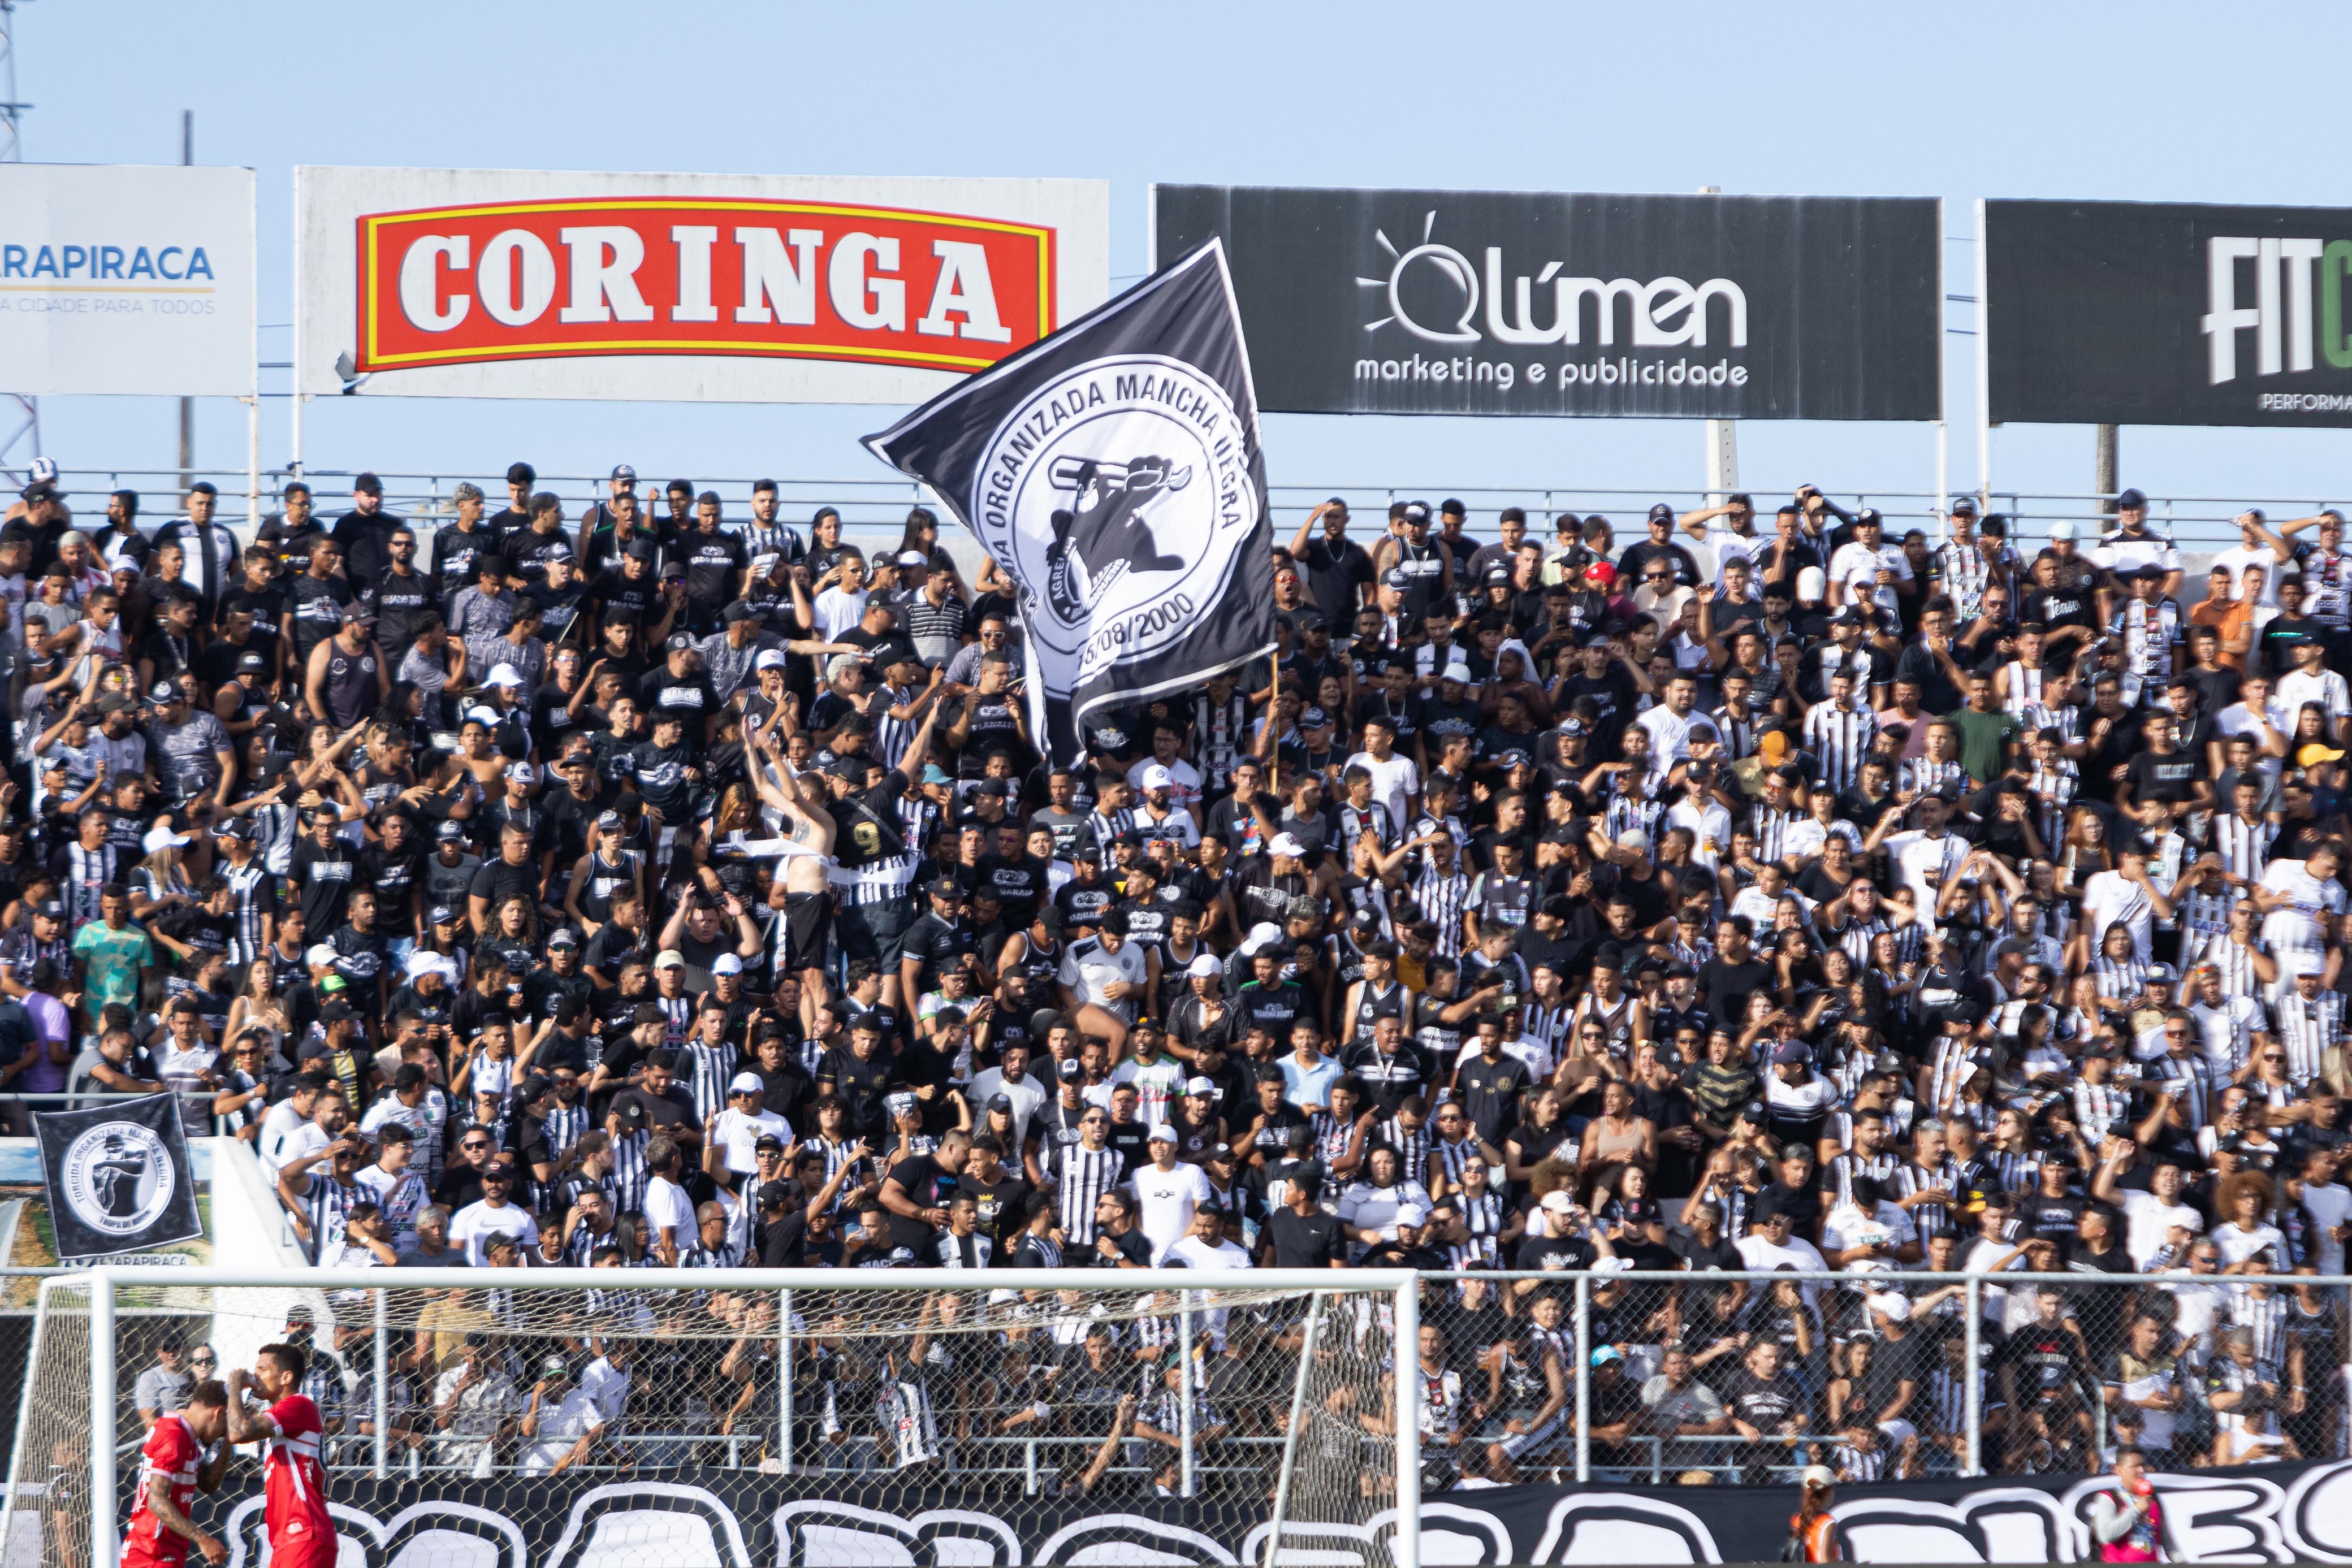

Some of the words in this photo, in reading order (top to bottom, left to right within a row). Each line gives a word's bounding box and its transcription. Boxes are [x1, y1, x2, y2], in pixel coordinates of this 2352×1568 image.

[0, 244, 215, 279] RAPIRACA
[399, 225, 1011, 343] CORINGA
[19, 297, 88, 313] CIDADE
[94, 298, 145, 313] PARA
[150, 299, 215, 314] TODOS
[1356, 354, 1514, 391] marketing
[1527, 362, 1546, 383] e
[1559, 357, 1749, 389] publicidade
[987, 381, 1105, 529] ORGANIZADA
[1116, 373, 1220, 437] MANCHA
[1214, 435, 1242, 530] NEGRA
[853, 821, 881, 855] 9
[71, 1163, 86, 1203] TORCIDA
